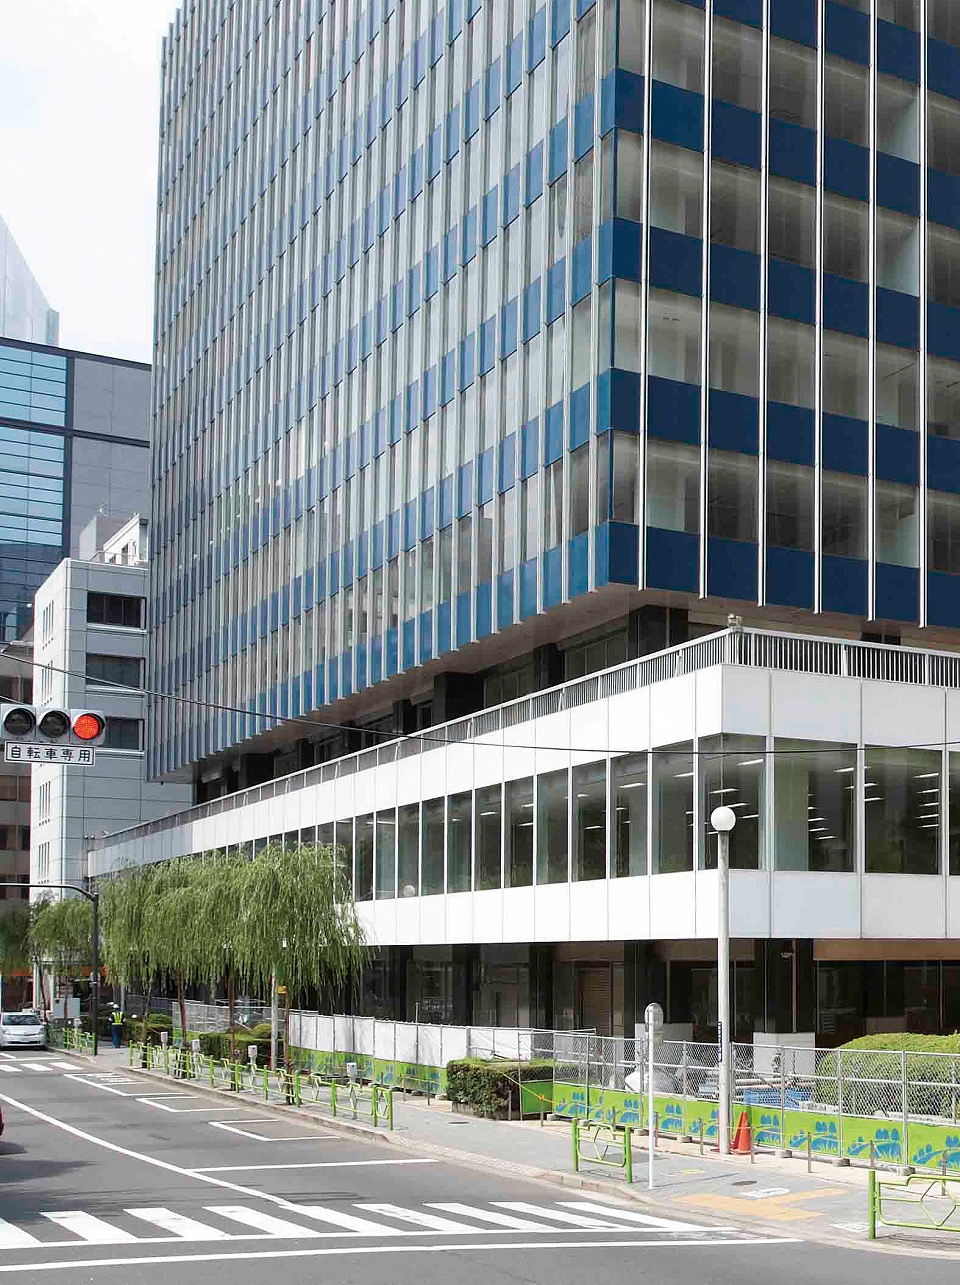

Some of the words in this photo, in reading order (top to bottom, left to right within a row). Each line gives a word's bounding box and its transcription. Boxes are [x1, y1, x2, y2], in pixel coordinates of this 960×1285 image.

[11, 746, 90, 762] 自転車専用
